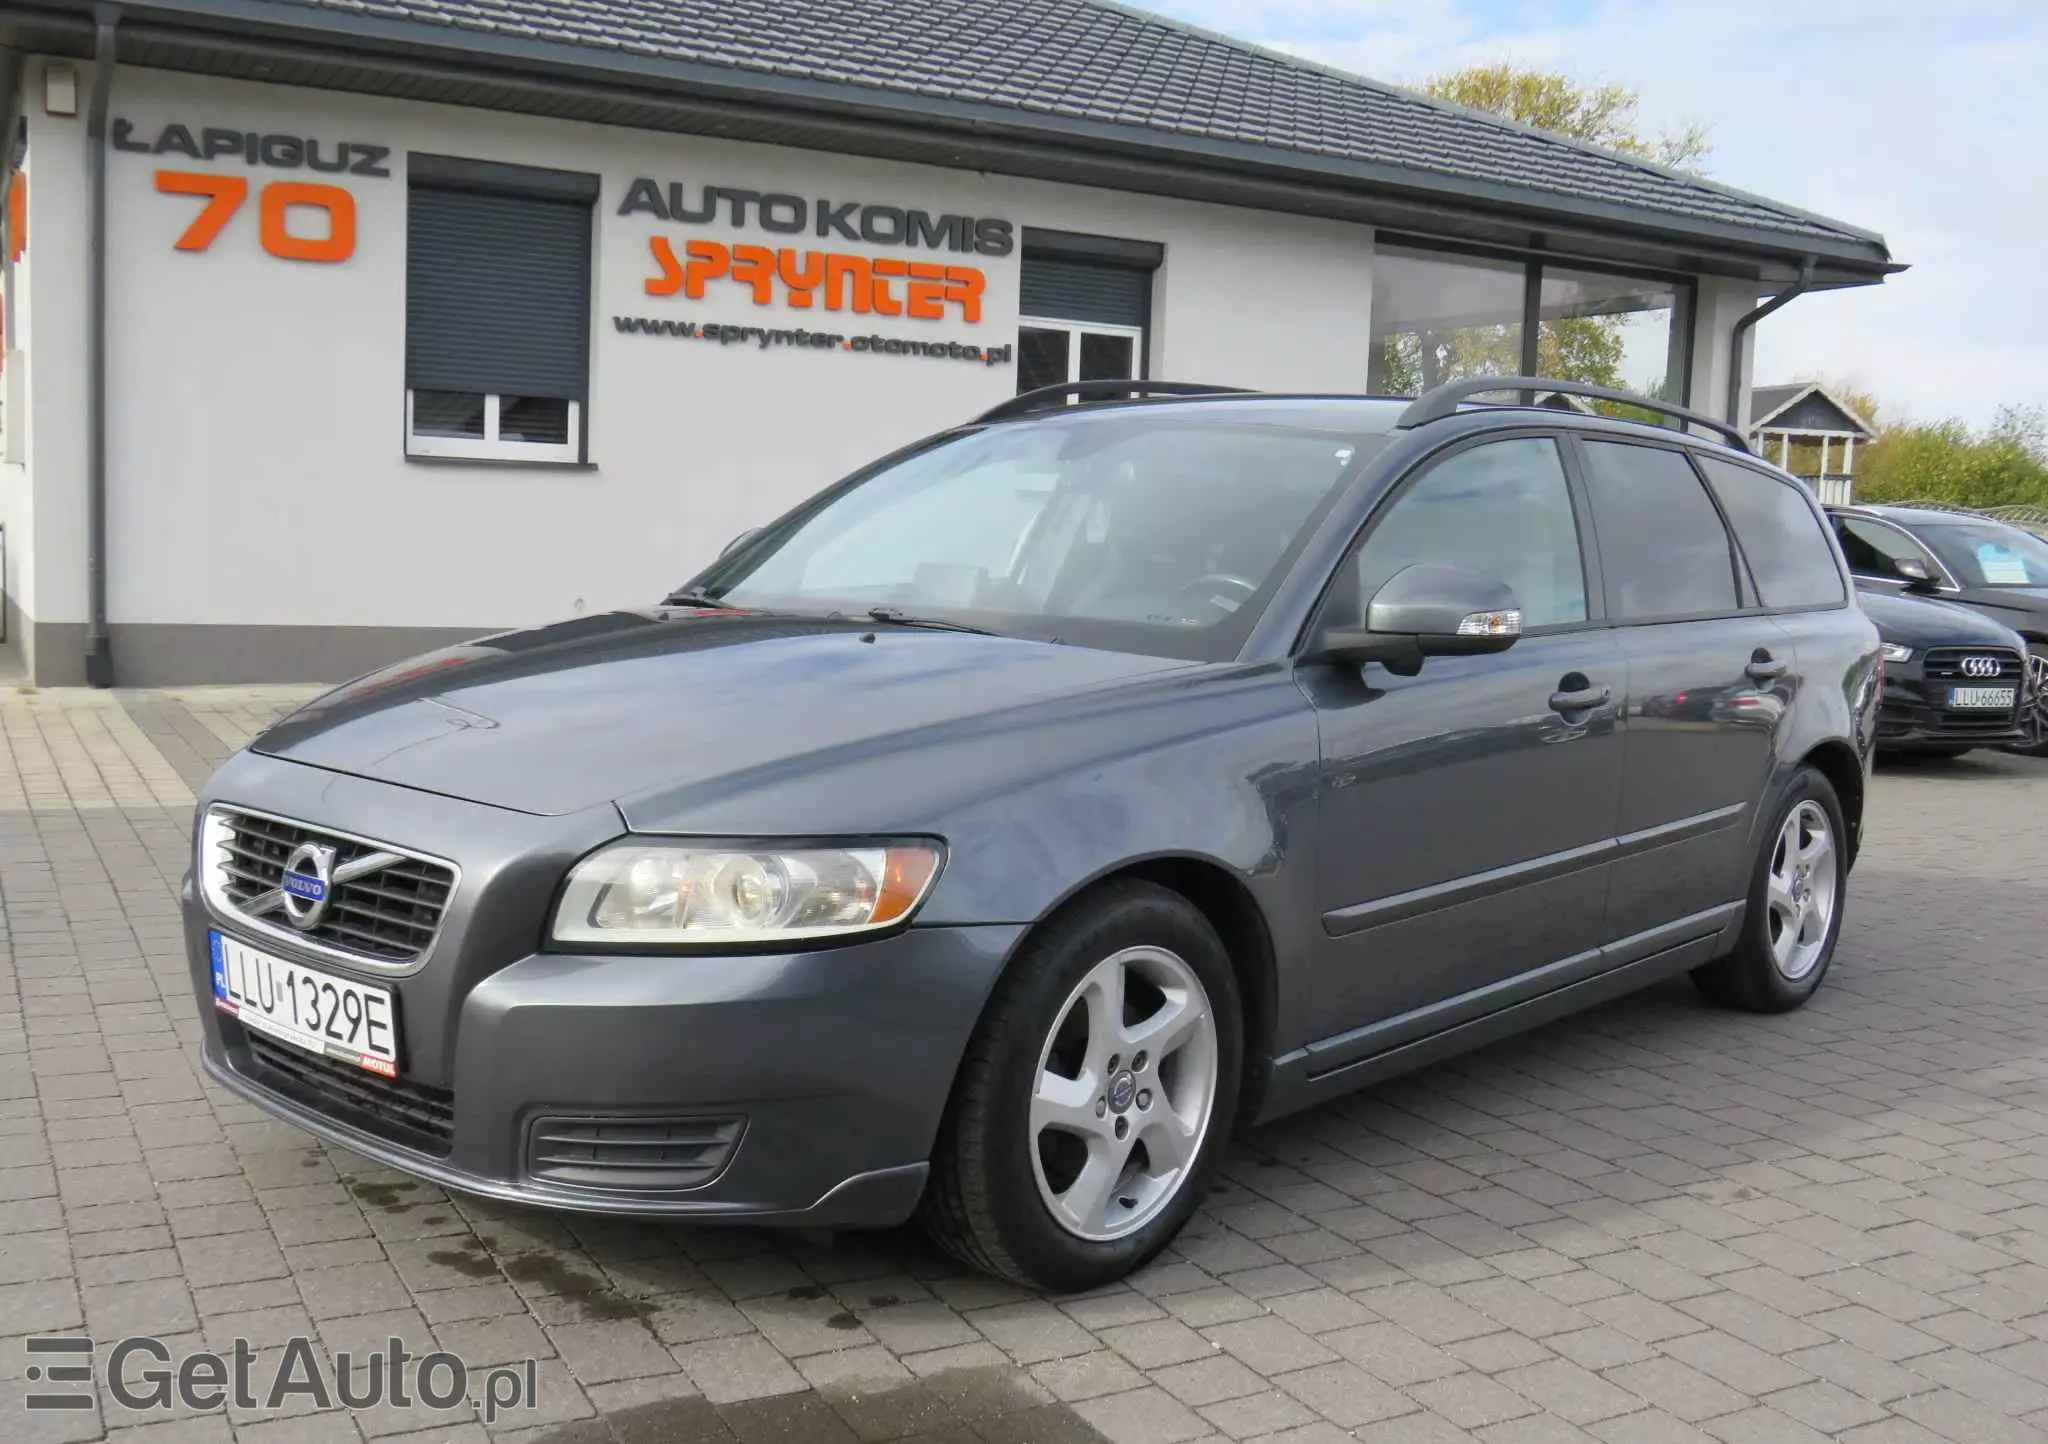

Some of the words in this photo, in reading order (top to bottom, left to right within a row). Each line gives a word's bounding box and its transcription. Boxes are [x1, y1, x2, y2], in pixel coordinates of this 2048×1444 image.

[113, 117, 391, 178] ŁAPIGUZ
[154, 169, 357, 263] 70
[617, 178, 807, 234] AUTO
[817, 200, 1014, 257] KOMIS
[644, 236, 986, 322] SPRYNTER
[613, 316, 1012, 364] www.sprynter.otomoto.pl
[287, 875, 322, 896] VOLVO
[225, 944, 275, 1014] LLU
[286, 970, 390, 1055] 1329E
